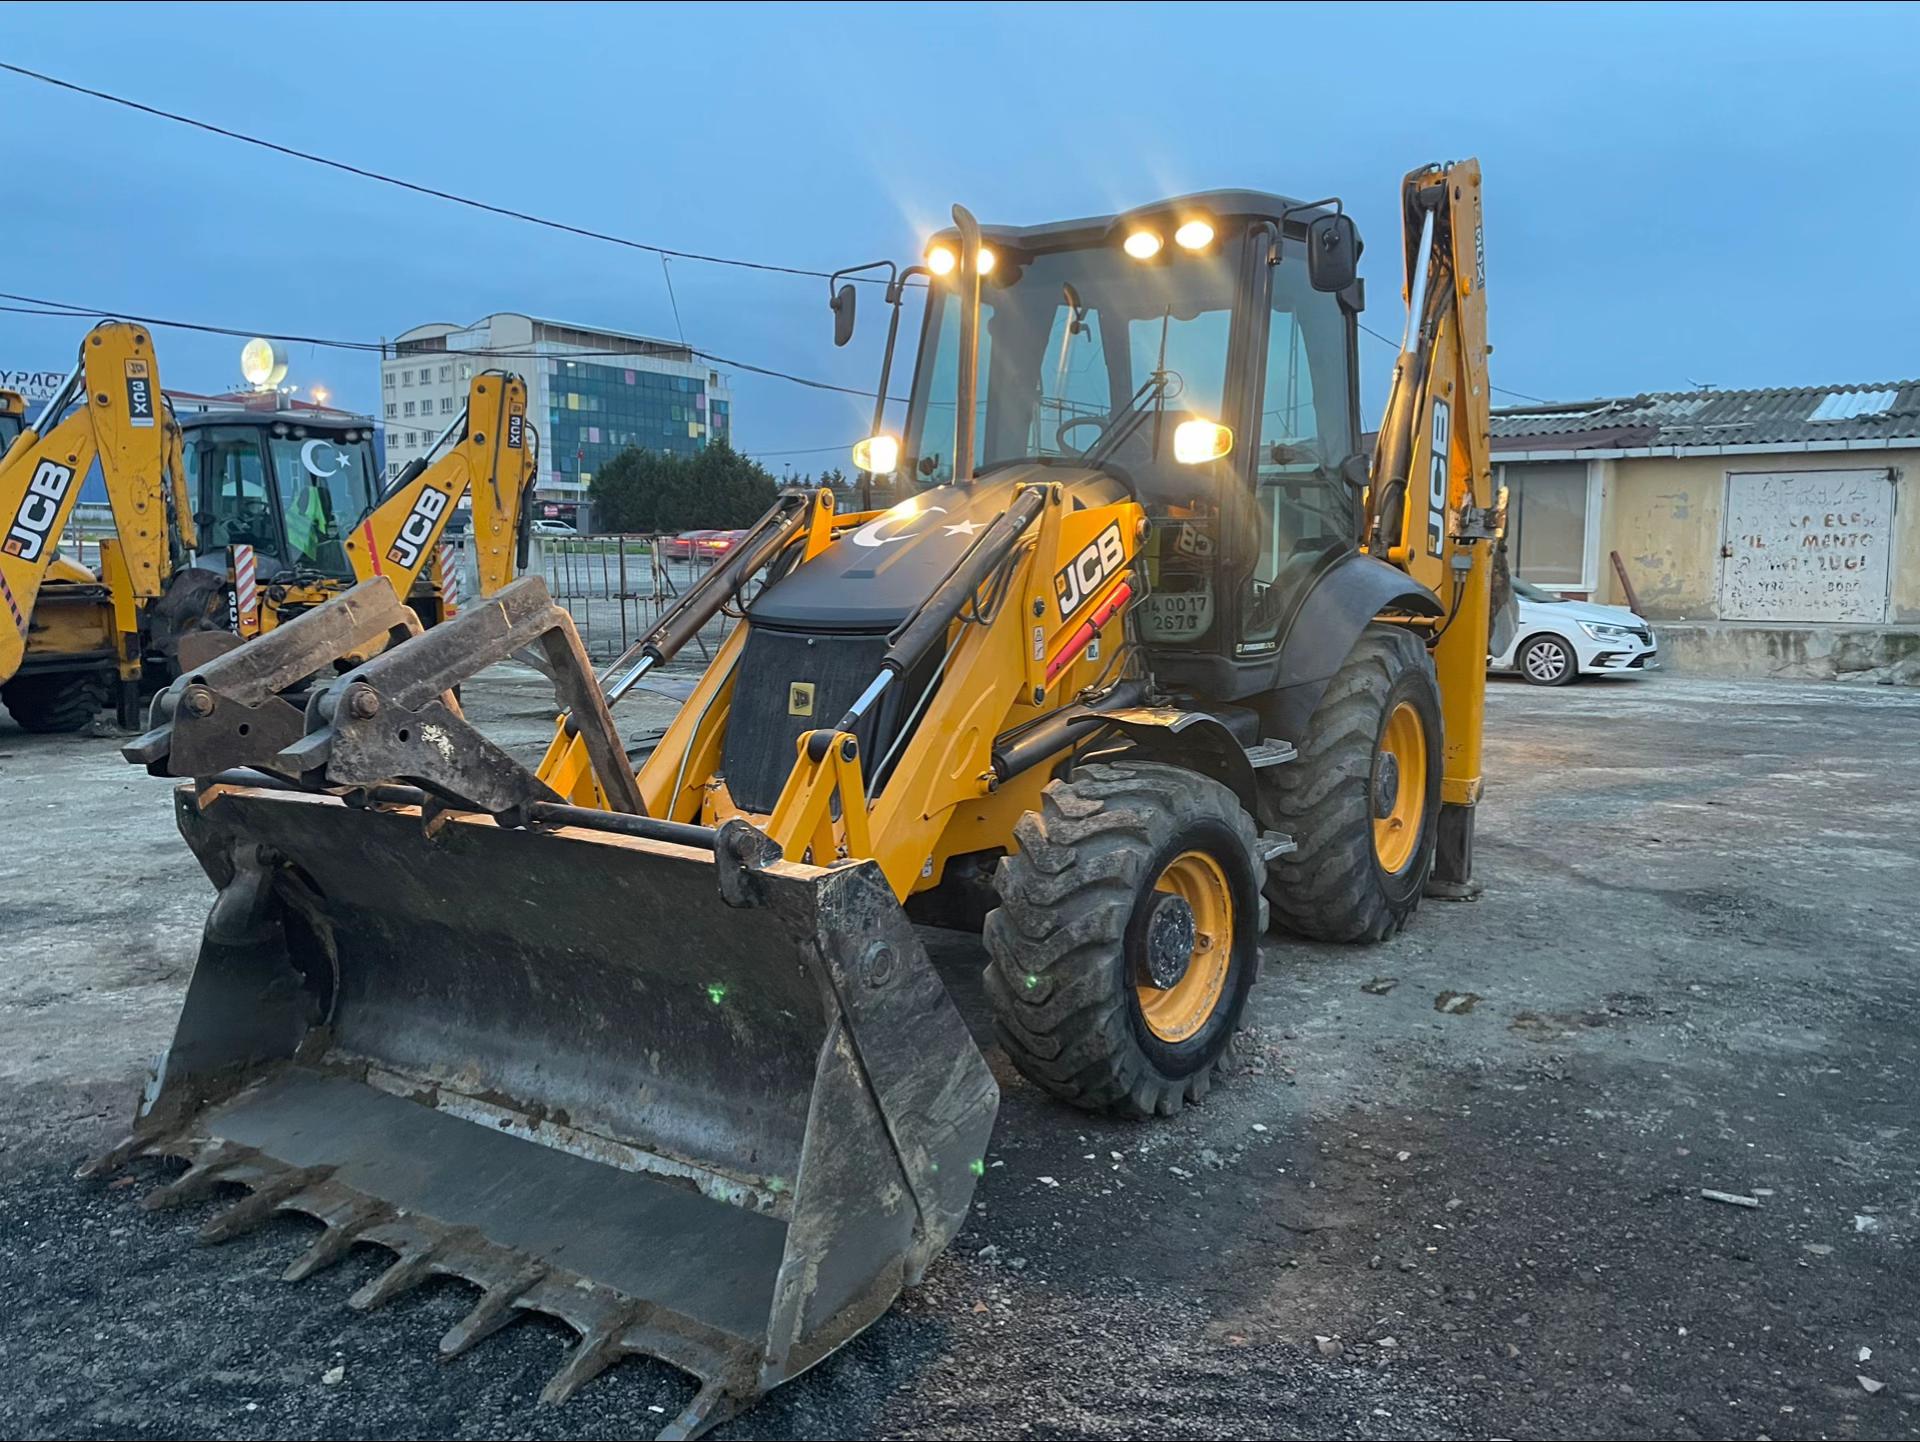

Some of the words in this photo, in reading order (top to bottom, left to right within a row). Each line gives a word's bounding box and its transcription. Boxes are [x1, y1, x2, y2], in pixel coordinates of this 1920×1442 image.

[1475, 227, 1484, 281] 3CX
[132, 381, 148, 413] 3CX
[510, 416, 521, 444] 3CX
[11, 461, 71, 559] JCB
[1429, 402, 1449, 555] JCB
[394, 488, 447, 567] JCB
[1059, 524, 1124, 615] JCB
